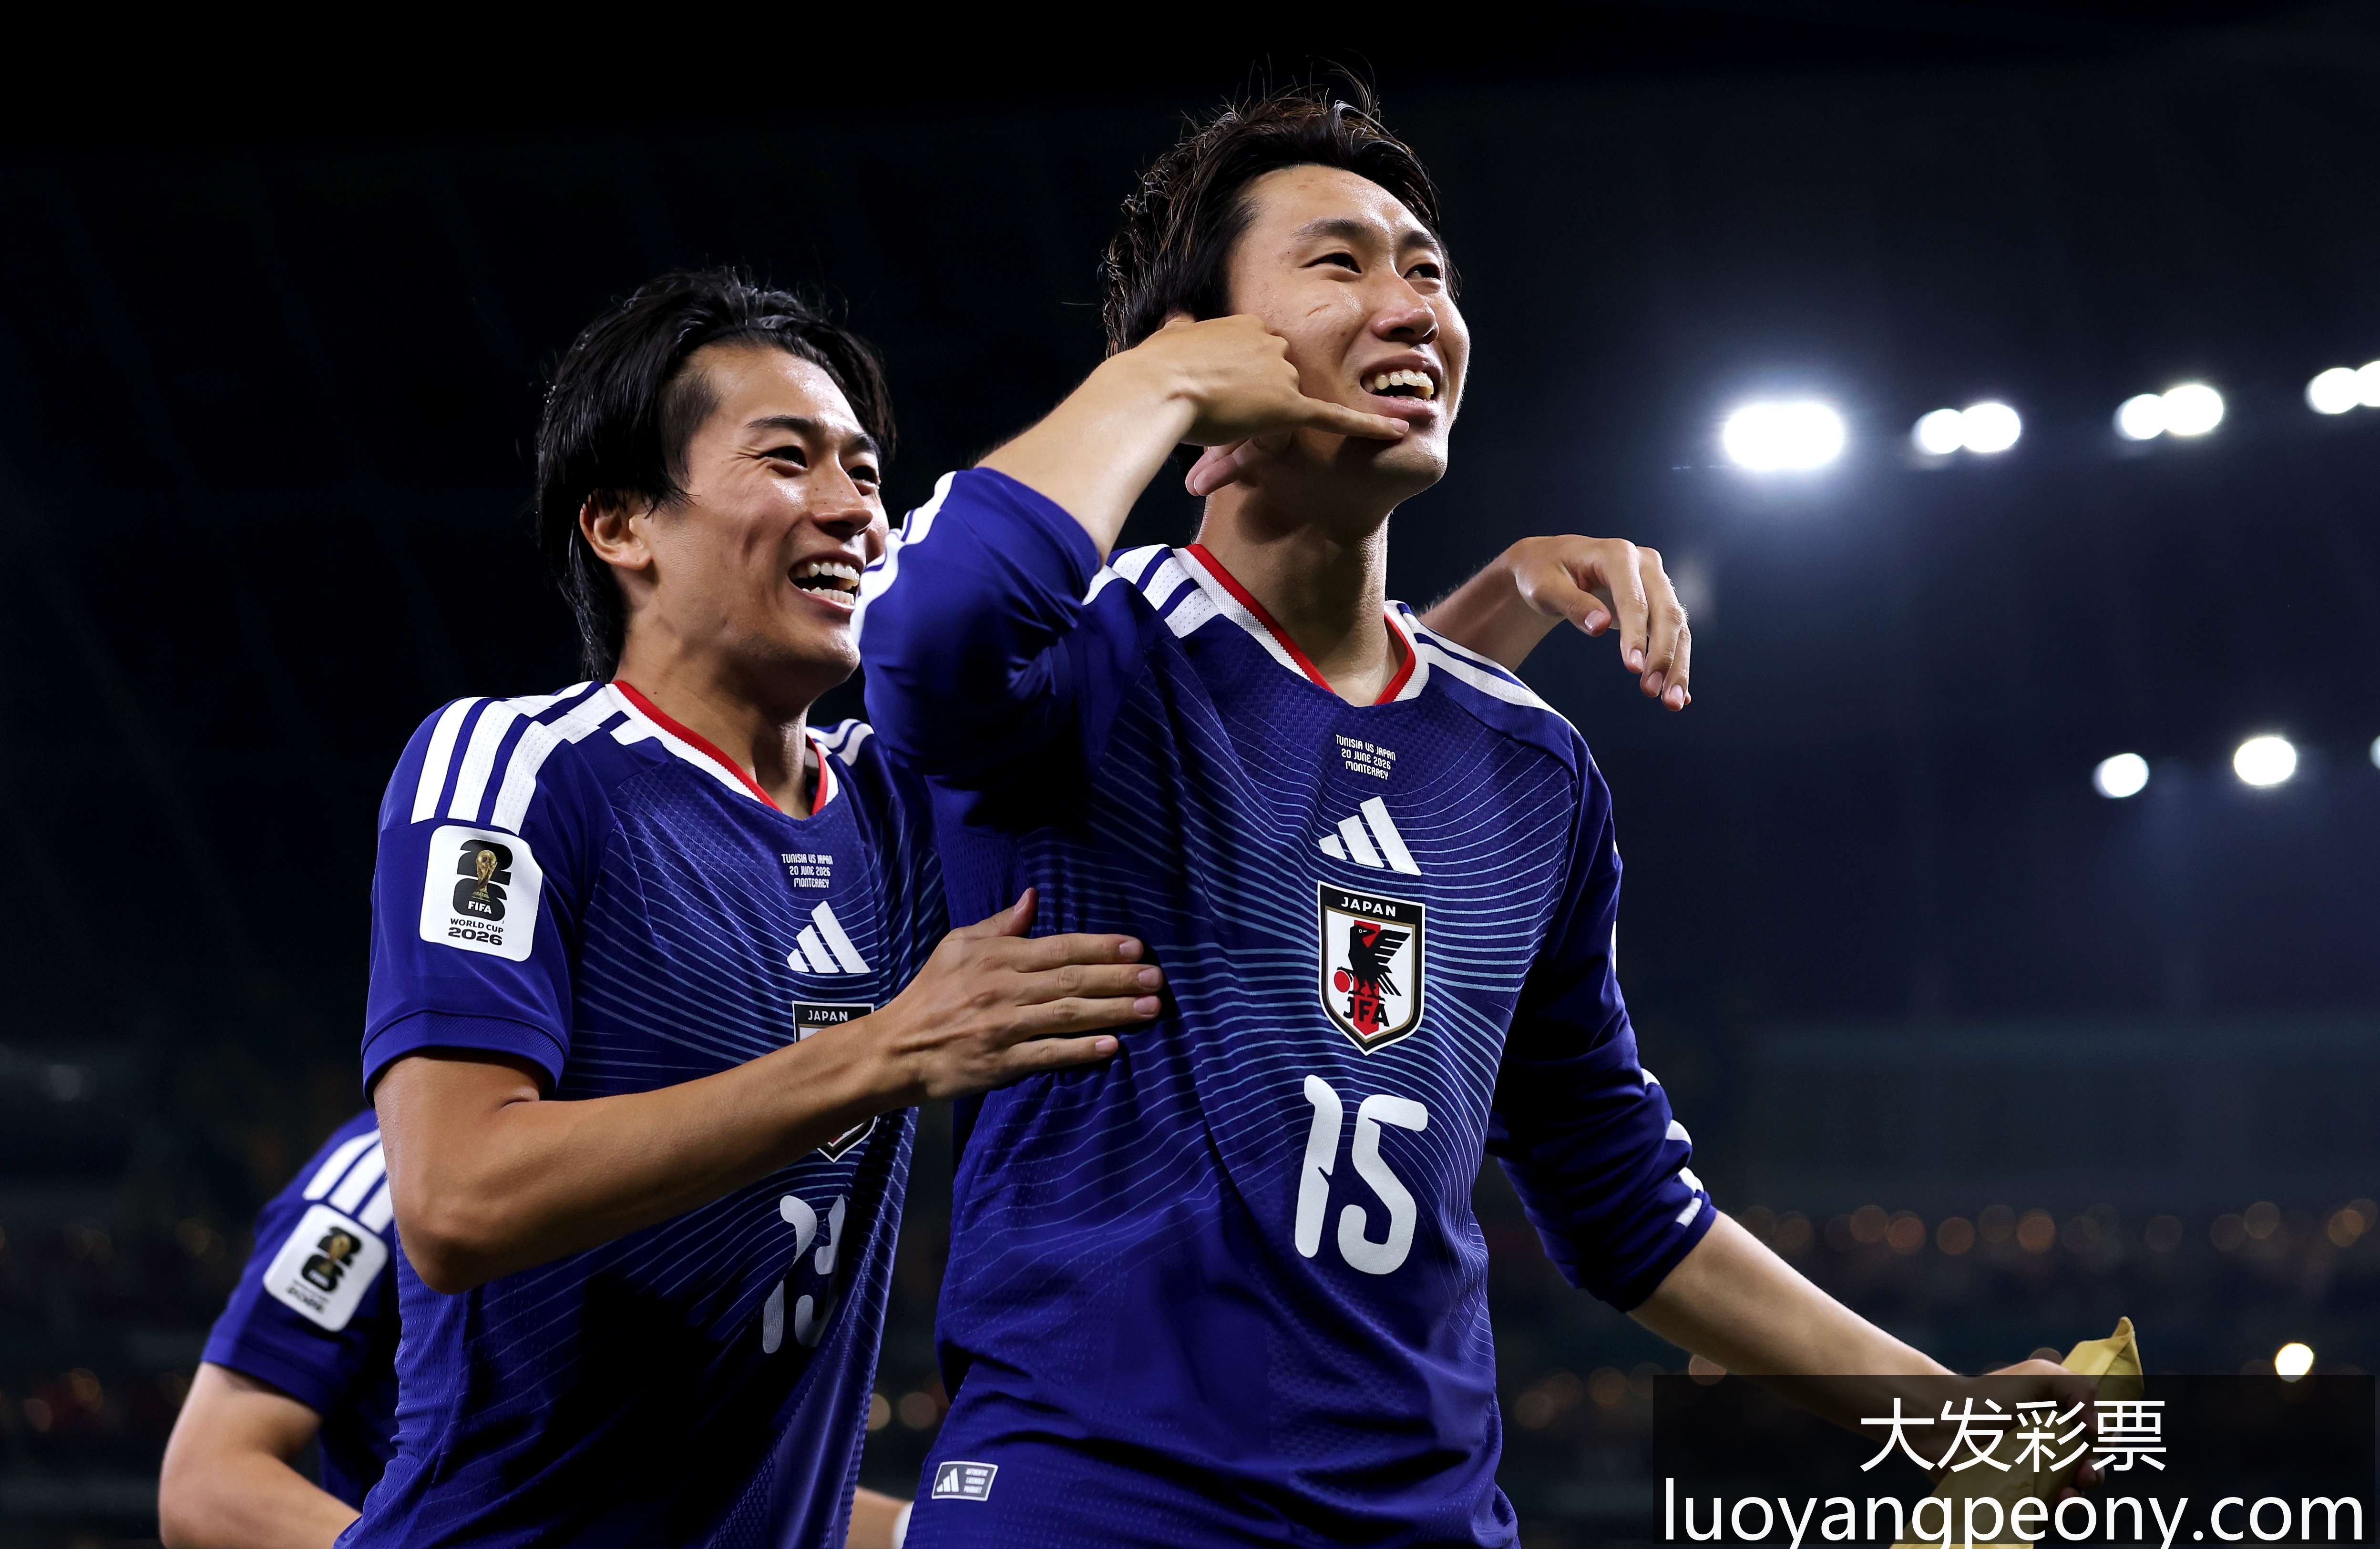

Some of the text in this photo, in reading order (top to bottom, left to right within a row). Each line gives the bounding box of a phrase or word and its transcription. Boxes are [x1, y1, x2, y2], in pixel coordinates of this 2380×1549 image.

[1336, 734, 1363, 750] TUNISIA
[1376, 746, 1396, 761] JAPAN
[1341, 748, 1391, 770] 20 JUNE 2026
[1345, 760, 1388, 780] MONTERREY
[781, 854, 807, 864] TUNISIA
[817, 854, 833, 865] JAPAN
[789, 866, 831, 876] 20 JUNE 2026
[794, 877, 829, 888] MONTERREY
[468, 901, 492, 914] FIFA
[1341, 897, 1396, 917] JAPAN
[450, 918, 503, 934] WORLD CUP
[448, 927, 503, 946] 2026
[808, 1010, 848, 1021] JAPAN
[1343, 997, 1390, 1027] JFA
[1295, 1074, 1428, 1274] 15
